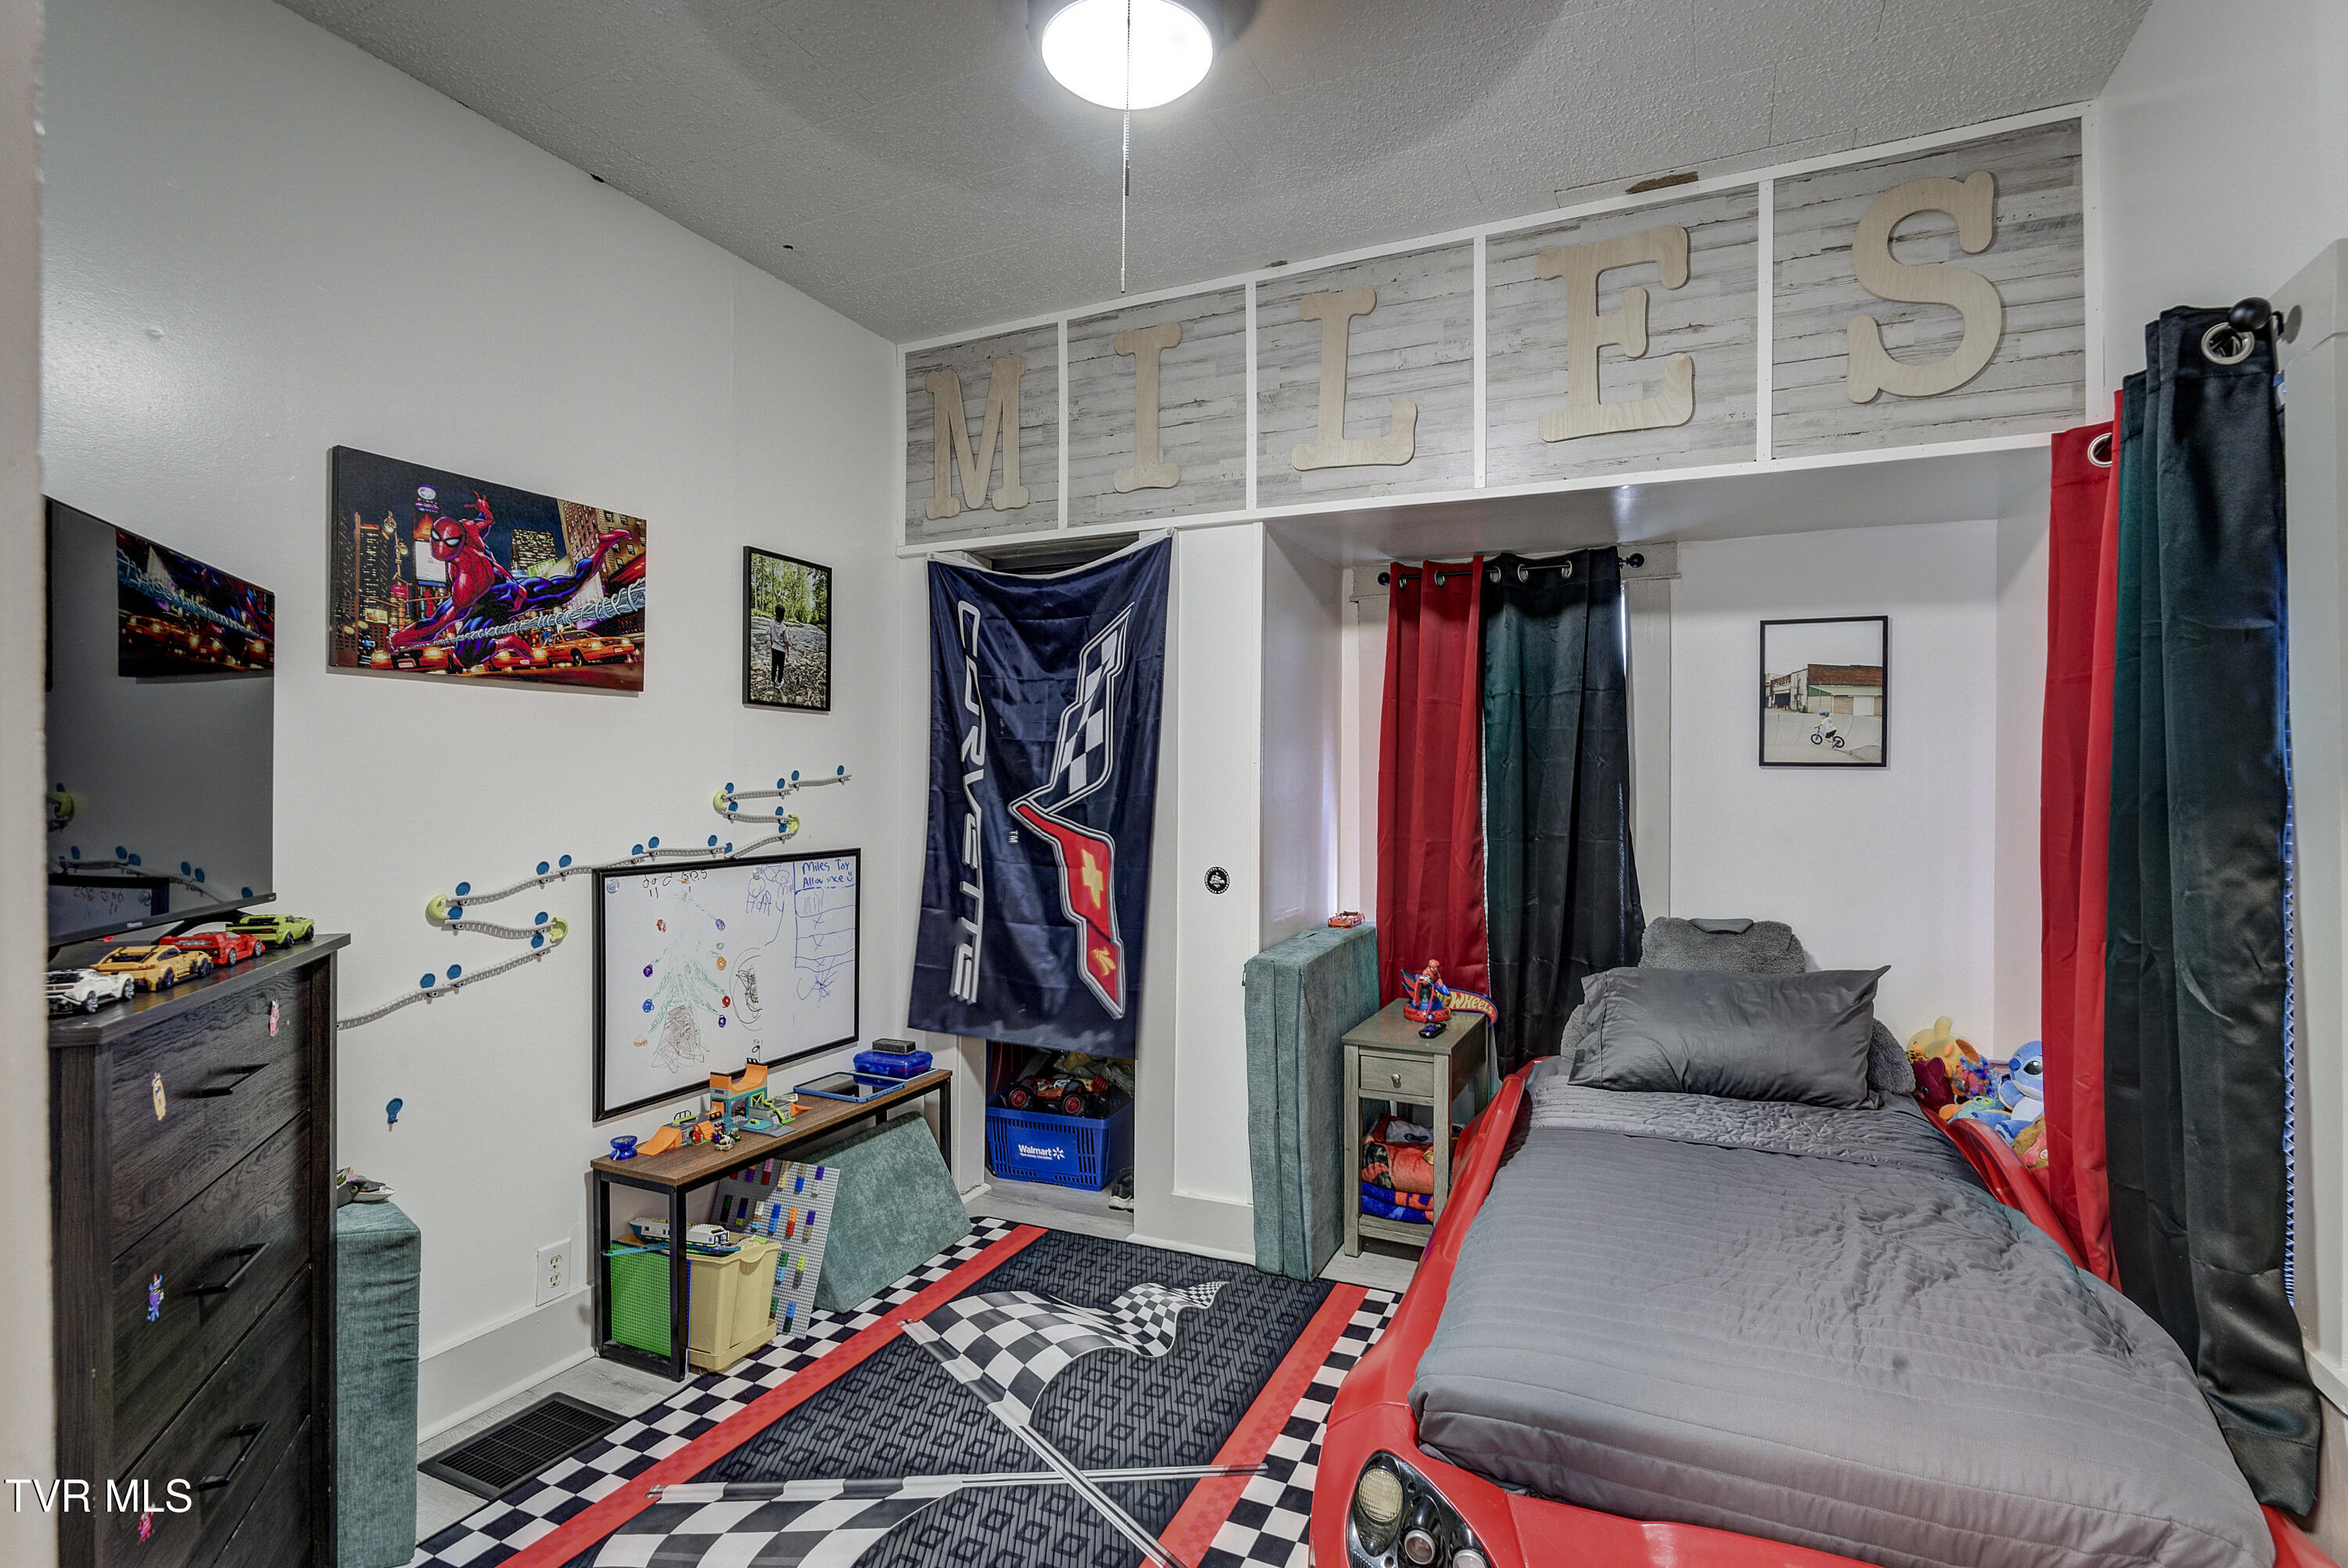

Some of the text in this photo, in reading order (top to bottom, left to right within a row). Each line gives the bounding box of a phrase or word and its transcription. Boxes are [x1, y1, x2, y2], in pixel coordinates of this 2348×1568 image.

[926, 171, 2002, 520] MILES
[802, 858, 850, 875] Miles Toy
[949, 599, 986, 1005] CORVETTE
[1017, 1144, 1052, 1156] Walmart
